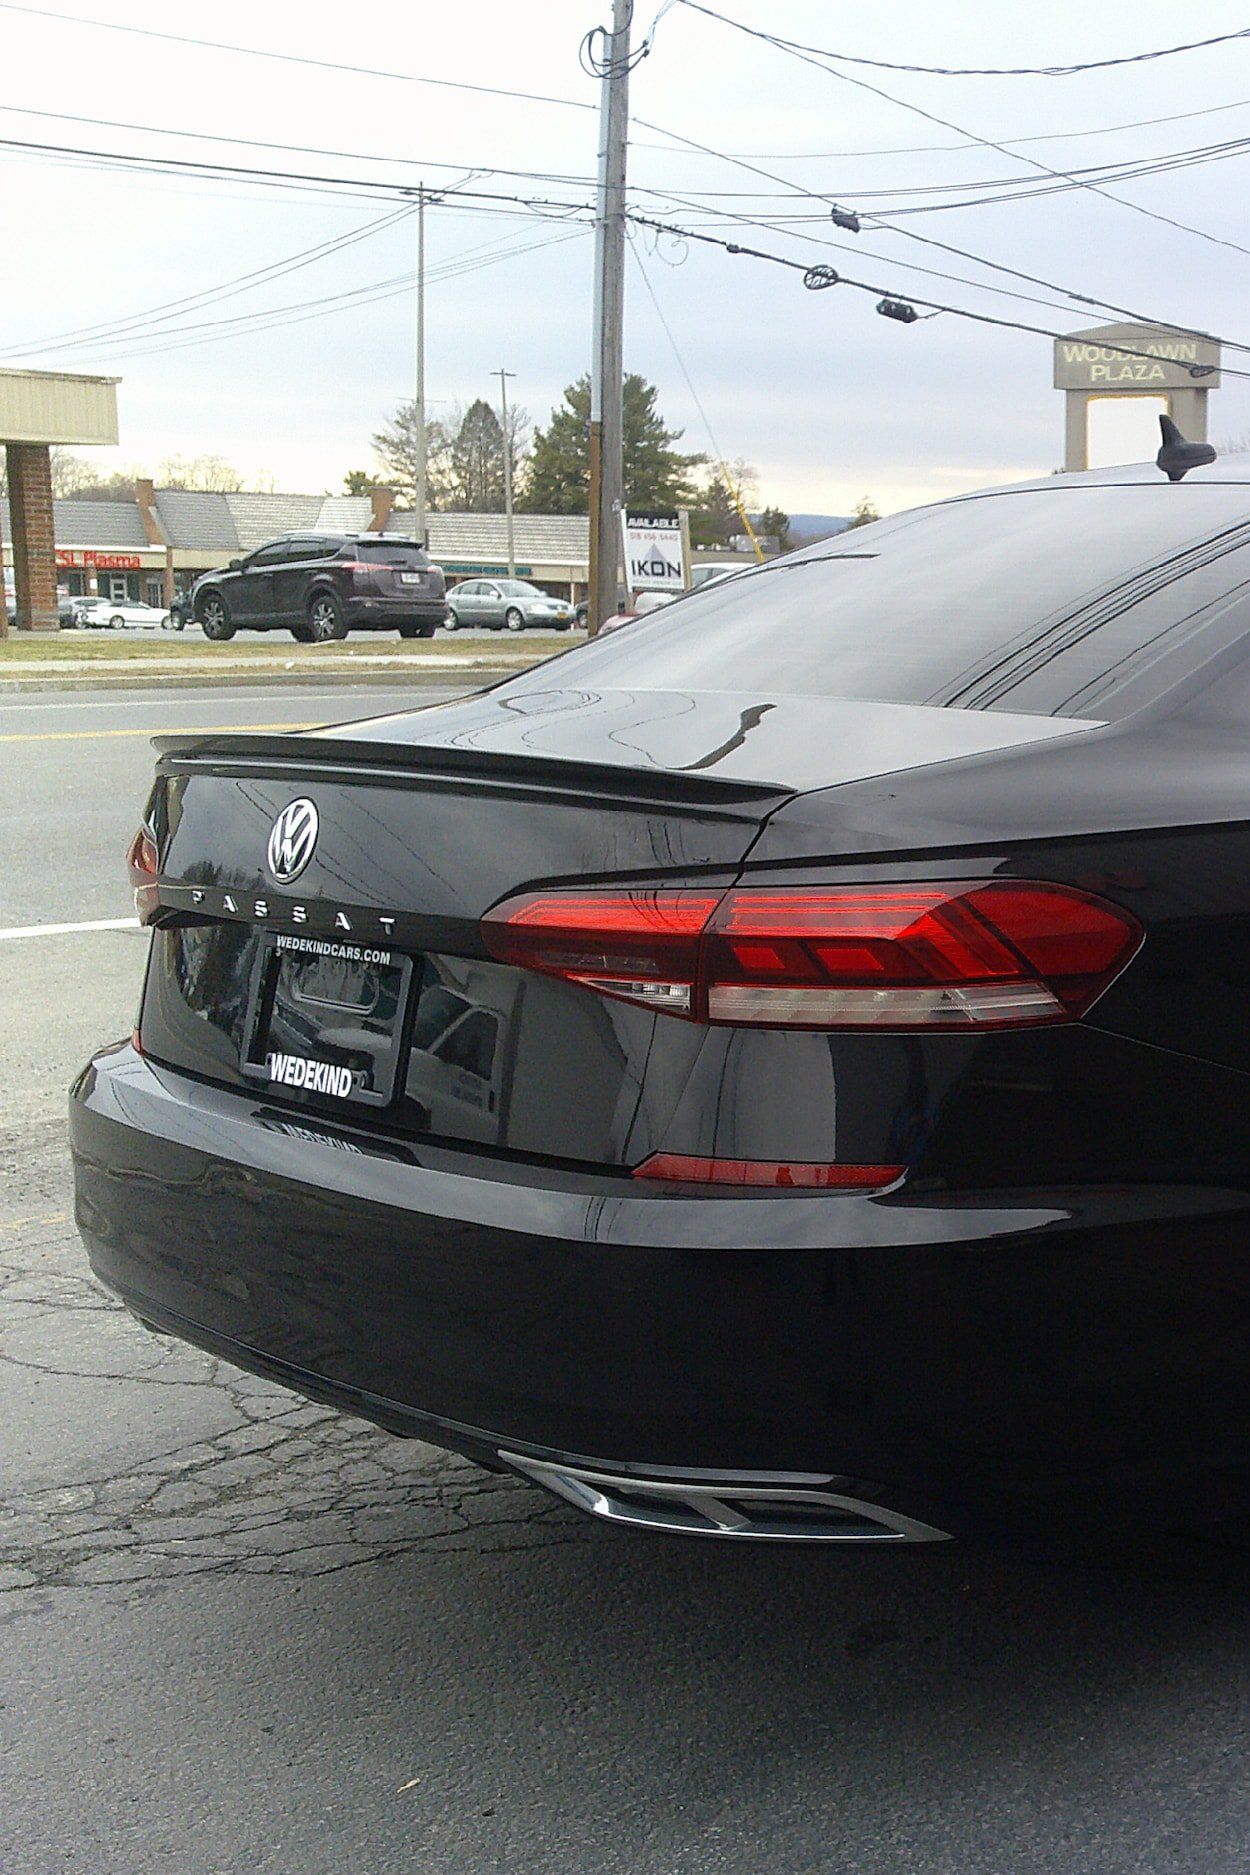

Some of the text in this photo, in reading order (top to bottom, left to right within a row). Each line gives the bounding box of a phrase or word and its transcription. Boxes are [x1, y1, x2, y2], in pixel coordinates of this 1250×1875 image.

[1062, 343, 1198, 363] WOODLAWN
[1091, 364, 1166, 381] PLAZA
[628, 517, 680, 529] AVAILABLE
[83, 550, 141, 569] Plasma
[631, 560, 682, 578] IKON
[191, 890, 397, 936] PASSAT
[276, 935, 391, 966] WEDEKINDCARS.COM
[270, 1052, 352, 1098] WEDEKIND
